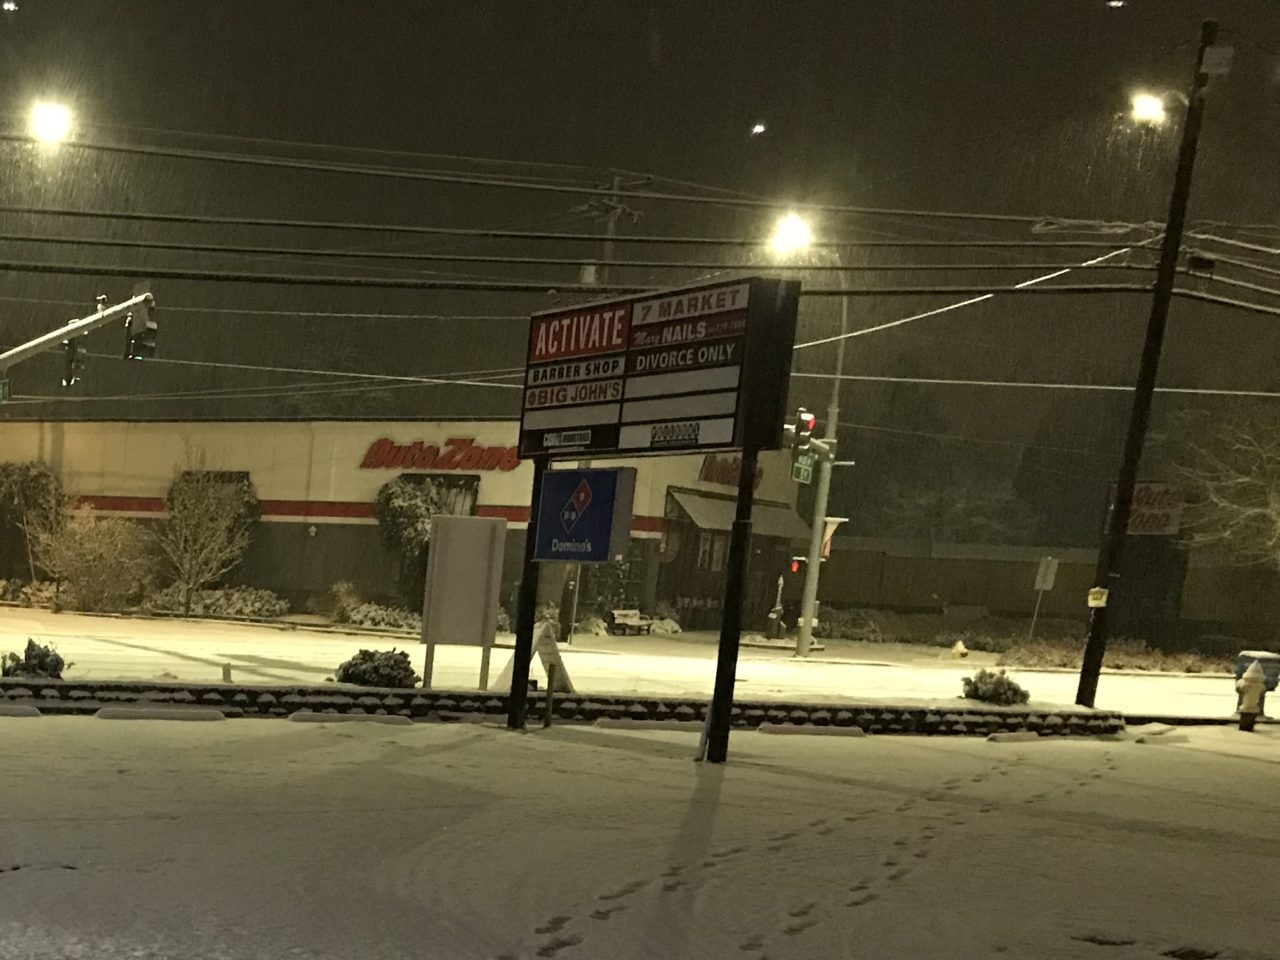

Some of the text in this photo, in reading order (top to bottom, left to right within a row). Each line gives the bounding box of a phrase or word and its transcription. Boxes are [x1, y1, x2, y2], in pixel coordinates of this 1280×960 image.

[640, 288, 741, 322] 7 MARKET
[535, 308, 625, 356] ACTIVATE
[661, 321, 707, 344] NAILS
[635, 343, 736, 371] DIVORCE ONLY
[532, 359, 620, 382] BARBER SHOP
[537, 381, 621, 406] BIG JOHN'S
[551, 538, 593, 553] Domino's
